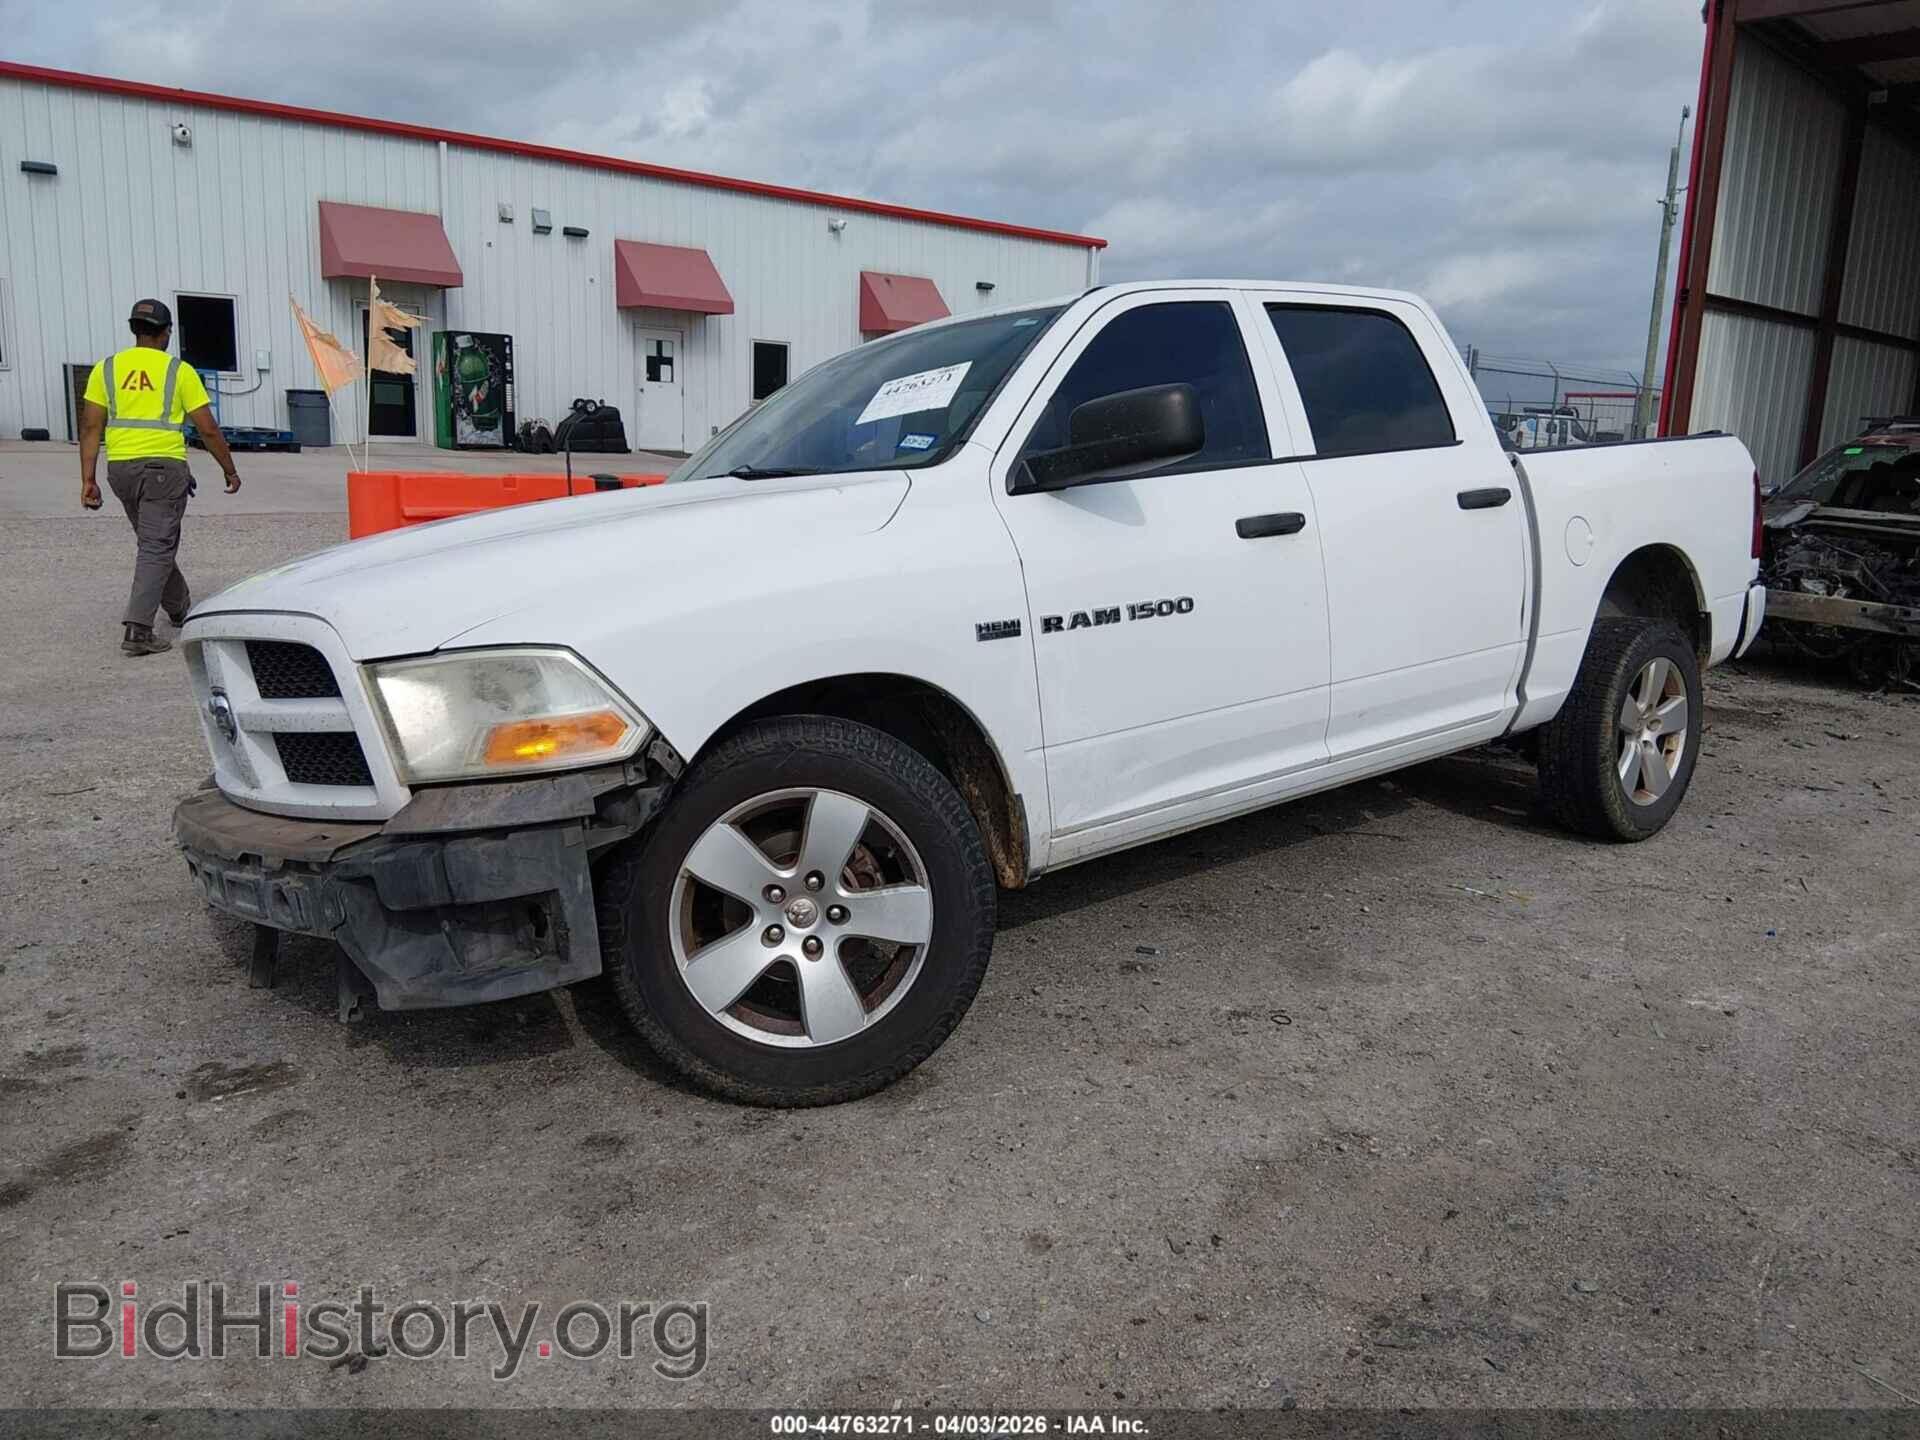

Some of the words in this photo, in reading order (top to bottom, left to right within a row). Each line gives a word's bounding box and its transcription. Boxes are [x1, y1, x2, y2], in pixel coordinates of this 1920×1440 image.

[975, 618, 1022, 634] HEMI
[1040, 606, 1121, 634] RAM
[1126, 596, 1195, 621] 1500
